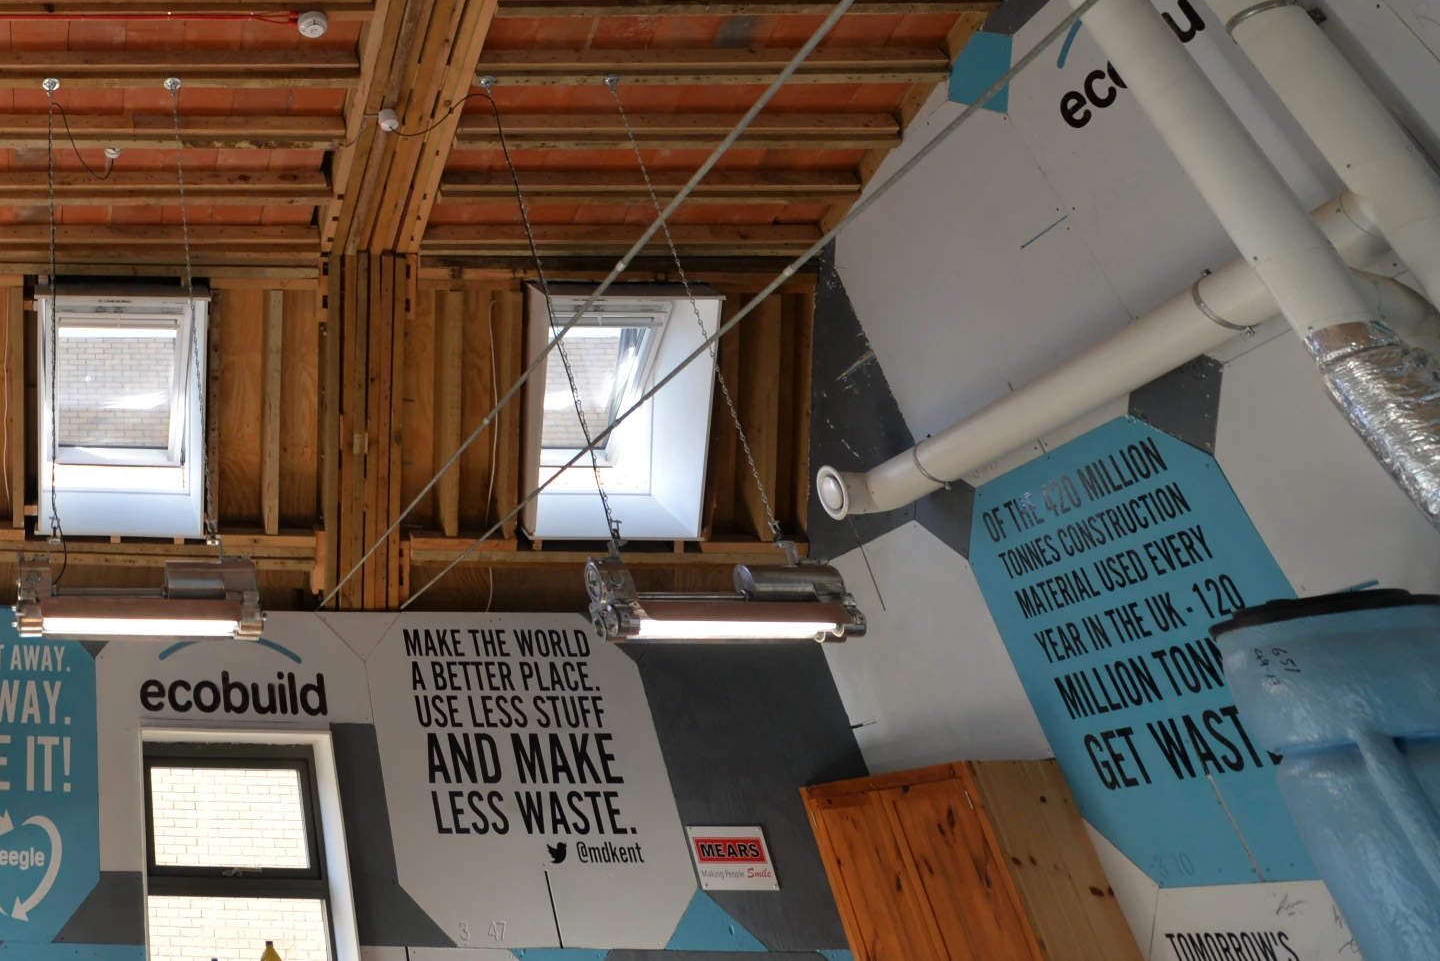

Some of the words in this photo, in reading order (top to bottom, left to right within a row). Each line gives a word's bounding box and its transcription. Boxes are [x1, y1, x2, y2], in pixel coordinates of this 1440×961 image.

[982, 507, 1007, 543] OF
[1003, 491, 1045, 533] THE
[1041, 475, 1082, 517] 420
[1076, 437, 1168, 502] MILLION
[998, 534, 1061, 579] TONNES
[1057, 482, 1191, 557] CONSTRUCTION
[1014, 567, 1101, 619] MATERIAL
[1093, 549, 1148, 592] USED
[1143, 525, 1213, 576] EVERY
[1034, 622, 1089, 663] YEAR
[1082, 614, 1112, 651] IN
[1104, 602, 1152, 643] THE
[1144, 591, 1187, 632] UK
[1192, 574, 1245, 619] 120
[10, 645, 71, 672] AWAY.
[403, 629, 465, 657] MAKE
[467, 629, 511, 657] THE
[513, 629, 591, 658] WORLD
[140, 670, 328, 716] ecobuild
[411, 661, 426, 691] A
[431, 661, 515, 691] BETTER
[518, 661, 600, 691] PLACE.
[1054, 656, 1163, 720] MILLION
[414, 695, 463, 728] USE
[467, 695, 528, 728] LESS
[532, 695, 605, 728] STUFF
[26, 735, 72, 792] IT!
[427, 733, 502, 784] AND
[510, 733, 625, 784] MAKE
[1084, 727, 1152, 790] GET
[1146, 705, 1283, 779] WAST
[431, 790, 510, 835] LESS
[514, 790, 637, 835] WASTE.
[576, 841, 645, 864] @mdkent
[700, 843, 760, 858] MEARS
[701, 870, 724, 880] Making
[725, 869, 745, 880] People
[747, 867, 771, 878] Smile
